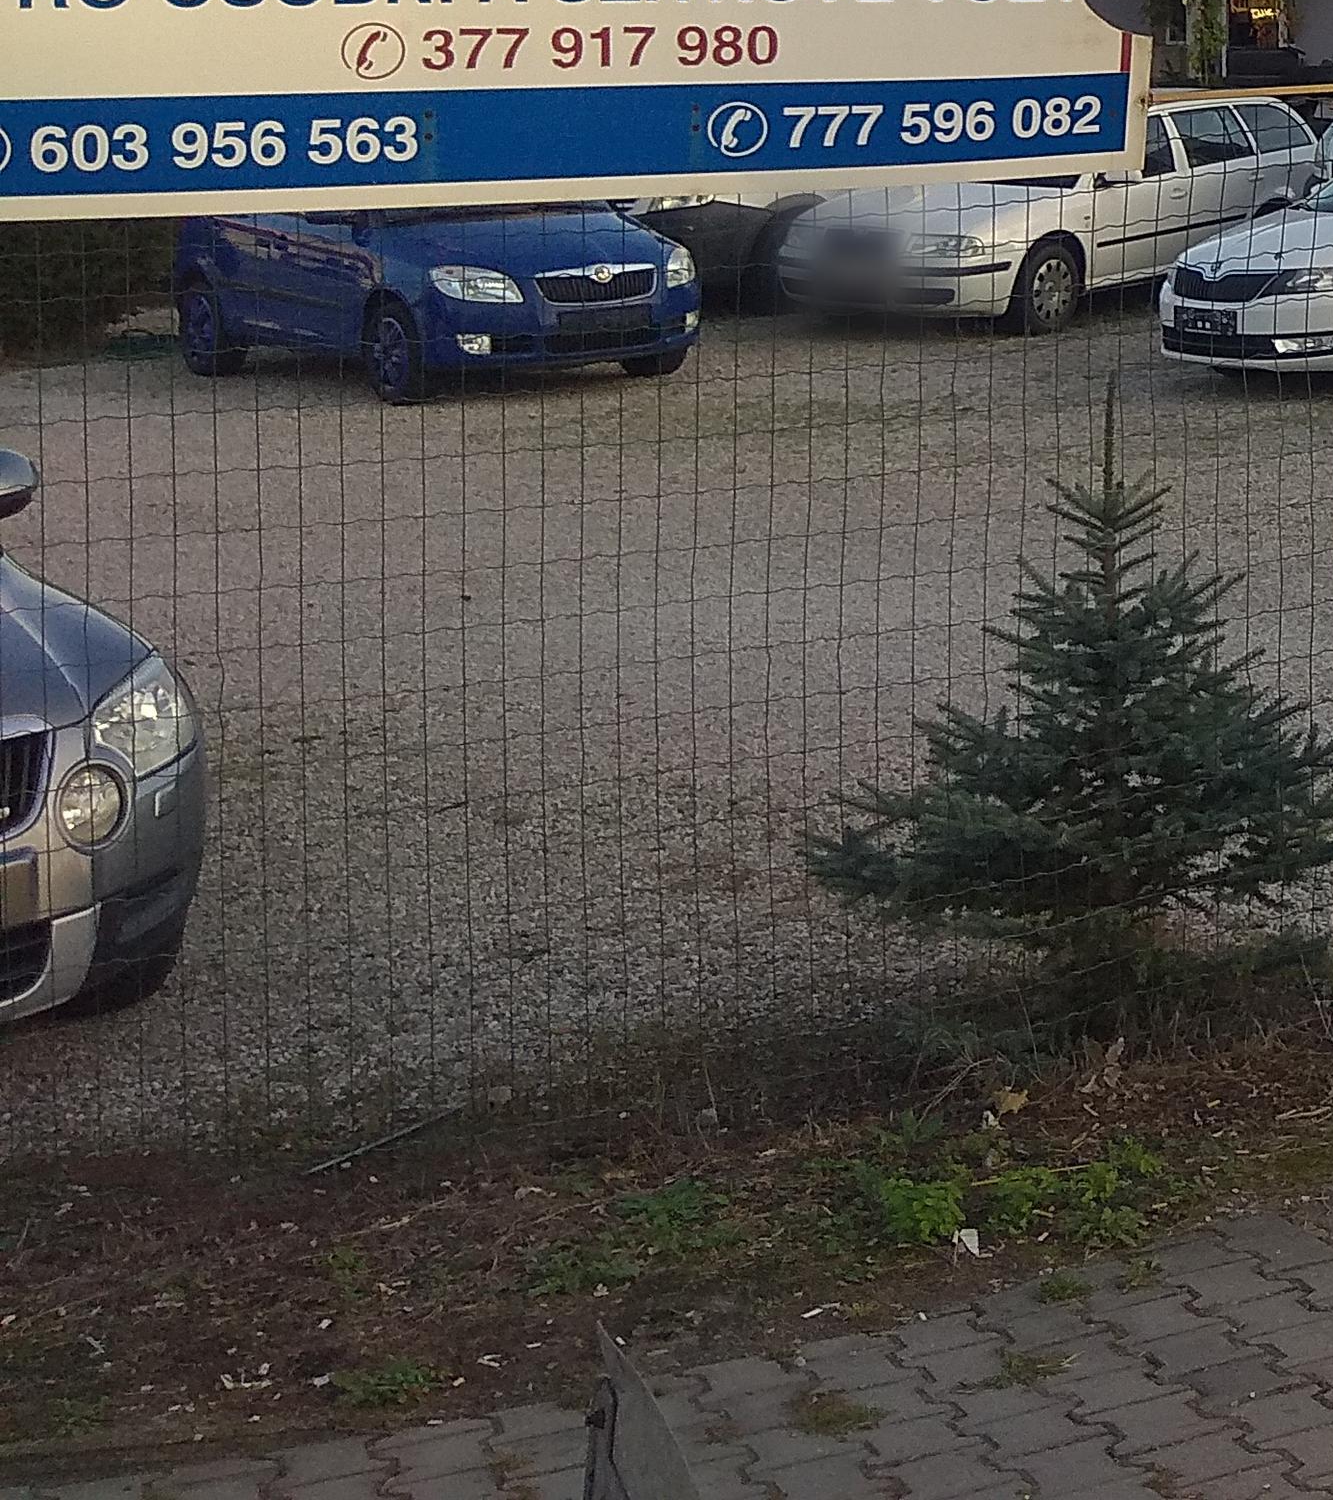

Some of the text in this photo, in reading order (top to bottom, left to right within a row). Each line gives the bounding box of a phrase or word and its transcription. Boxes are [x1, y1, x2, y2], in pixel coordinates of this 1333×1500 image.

[421, 24, 779, 70] 377 917 980
[29, 114, 419, 173] 603 956 563
[783, 95, 1101, 149] 777 596 082
